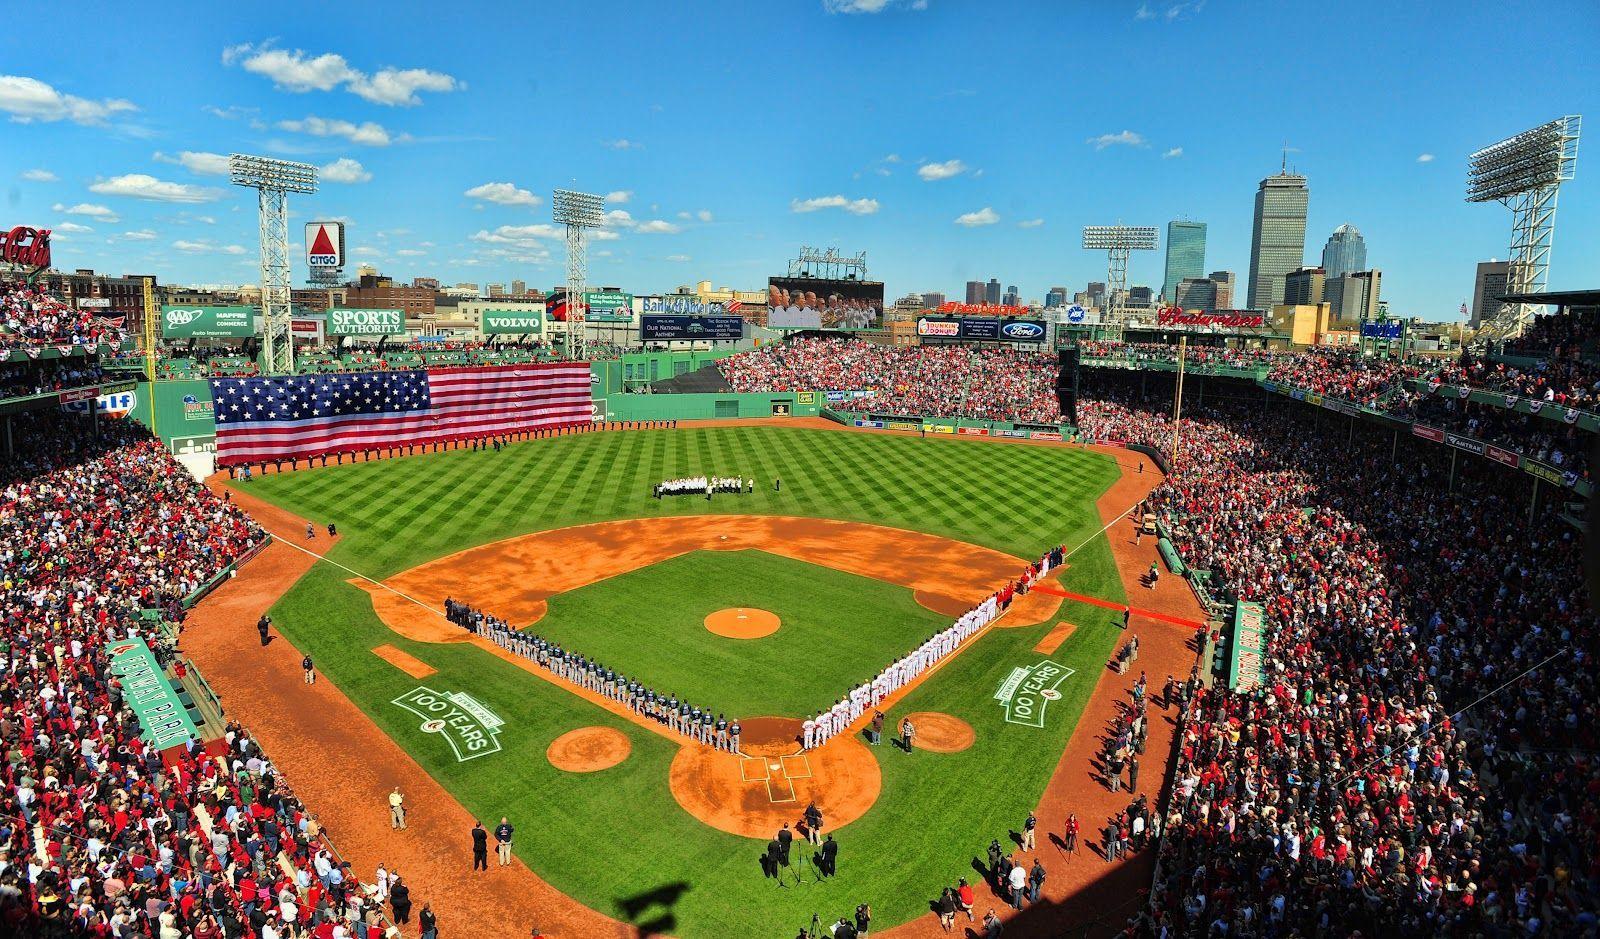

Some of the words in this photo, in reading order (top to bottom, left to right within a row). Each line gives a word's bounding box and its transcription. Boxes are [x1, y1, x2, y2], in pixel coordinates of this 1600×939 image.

[310, 255, 337, 265] CITGO
[643, 297, 671, 312] Bank
[684, 299, 723, 315] America
[167, 310, 193, 324] AAA
[332, 311, 400, 325] SPORTS
[487, 317, 540, 328] VOLVO
[1157, 306, 1264, 328] Budweiser
[1010, 324, 1035, 336] Ford
[1456, 440, 1482, 452] AMTRAK
[1020, 665, 1060, 696] YEARS
[118, 654, 167, 705] FENWAY
[143, 701, 190, 745] PARK
[1014, 697, 1034, 719] 100
[409, 693, 447, 712] 100
[442, 707, 488, 751] YEARS
